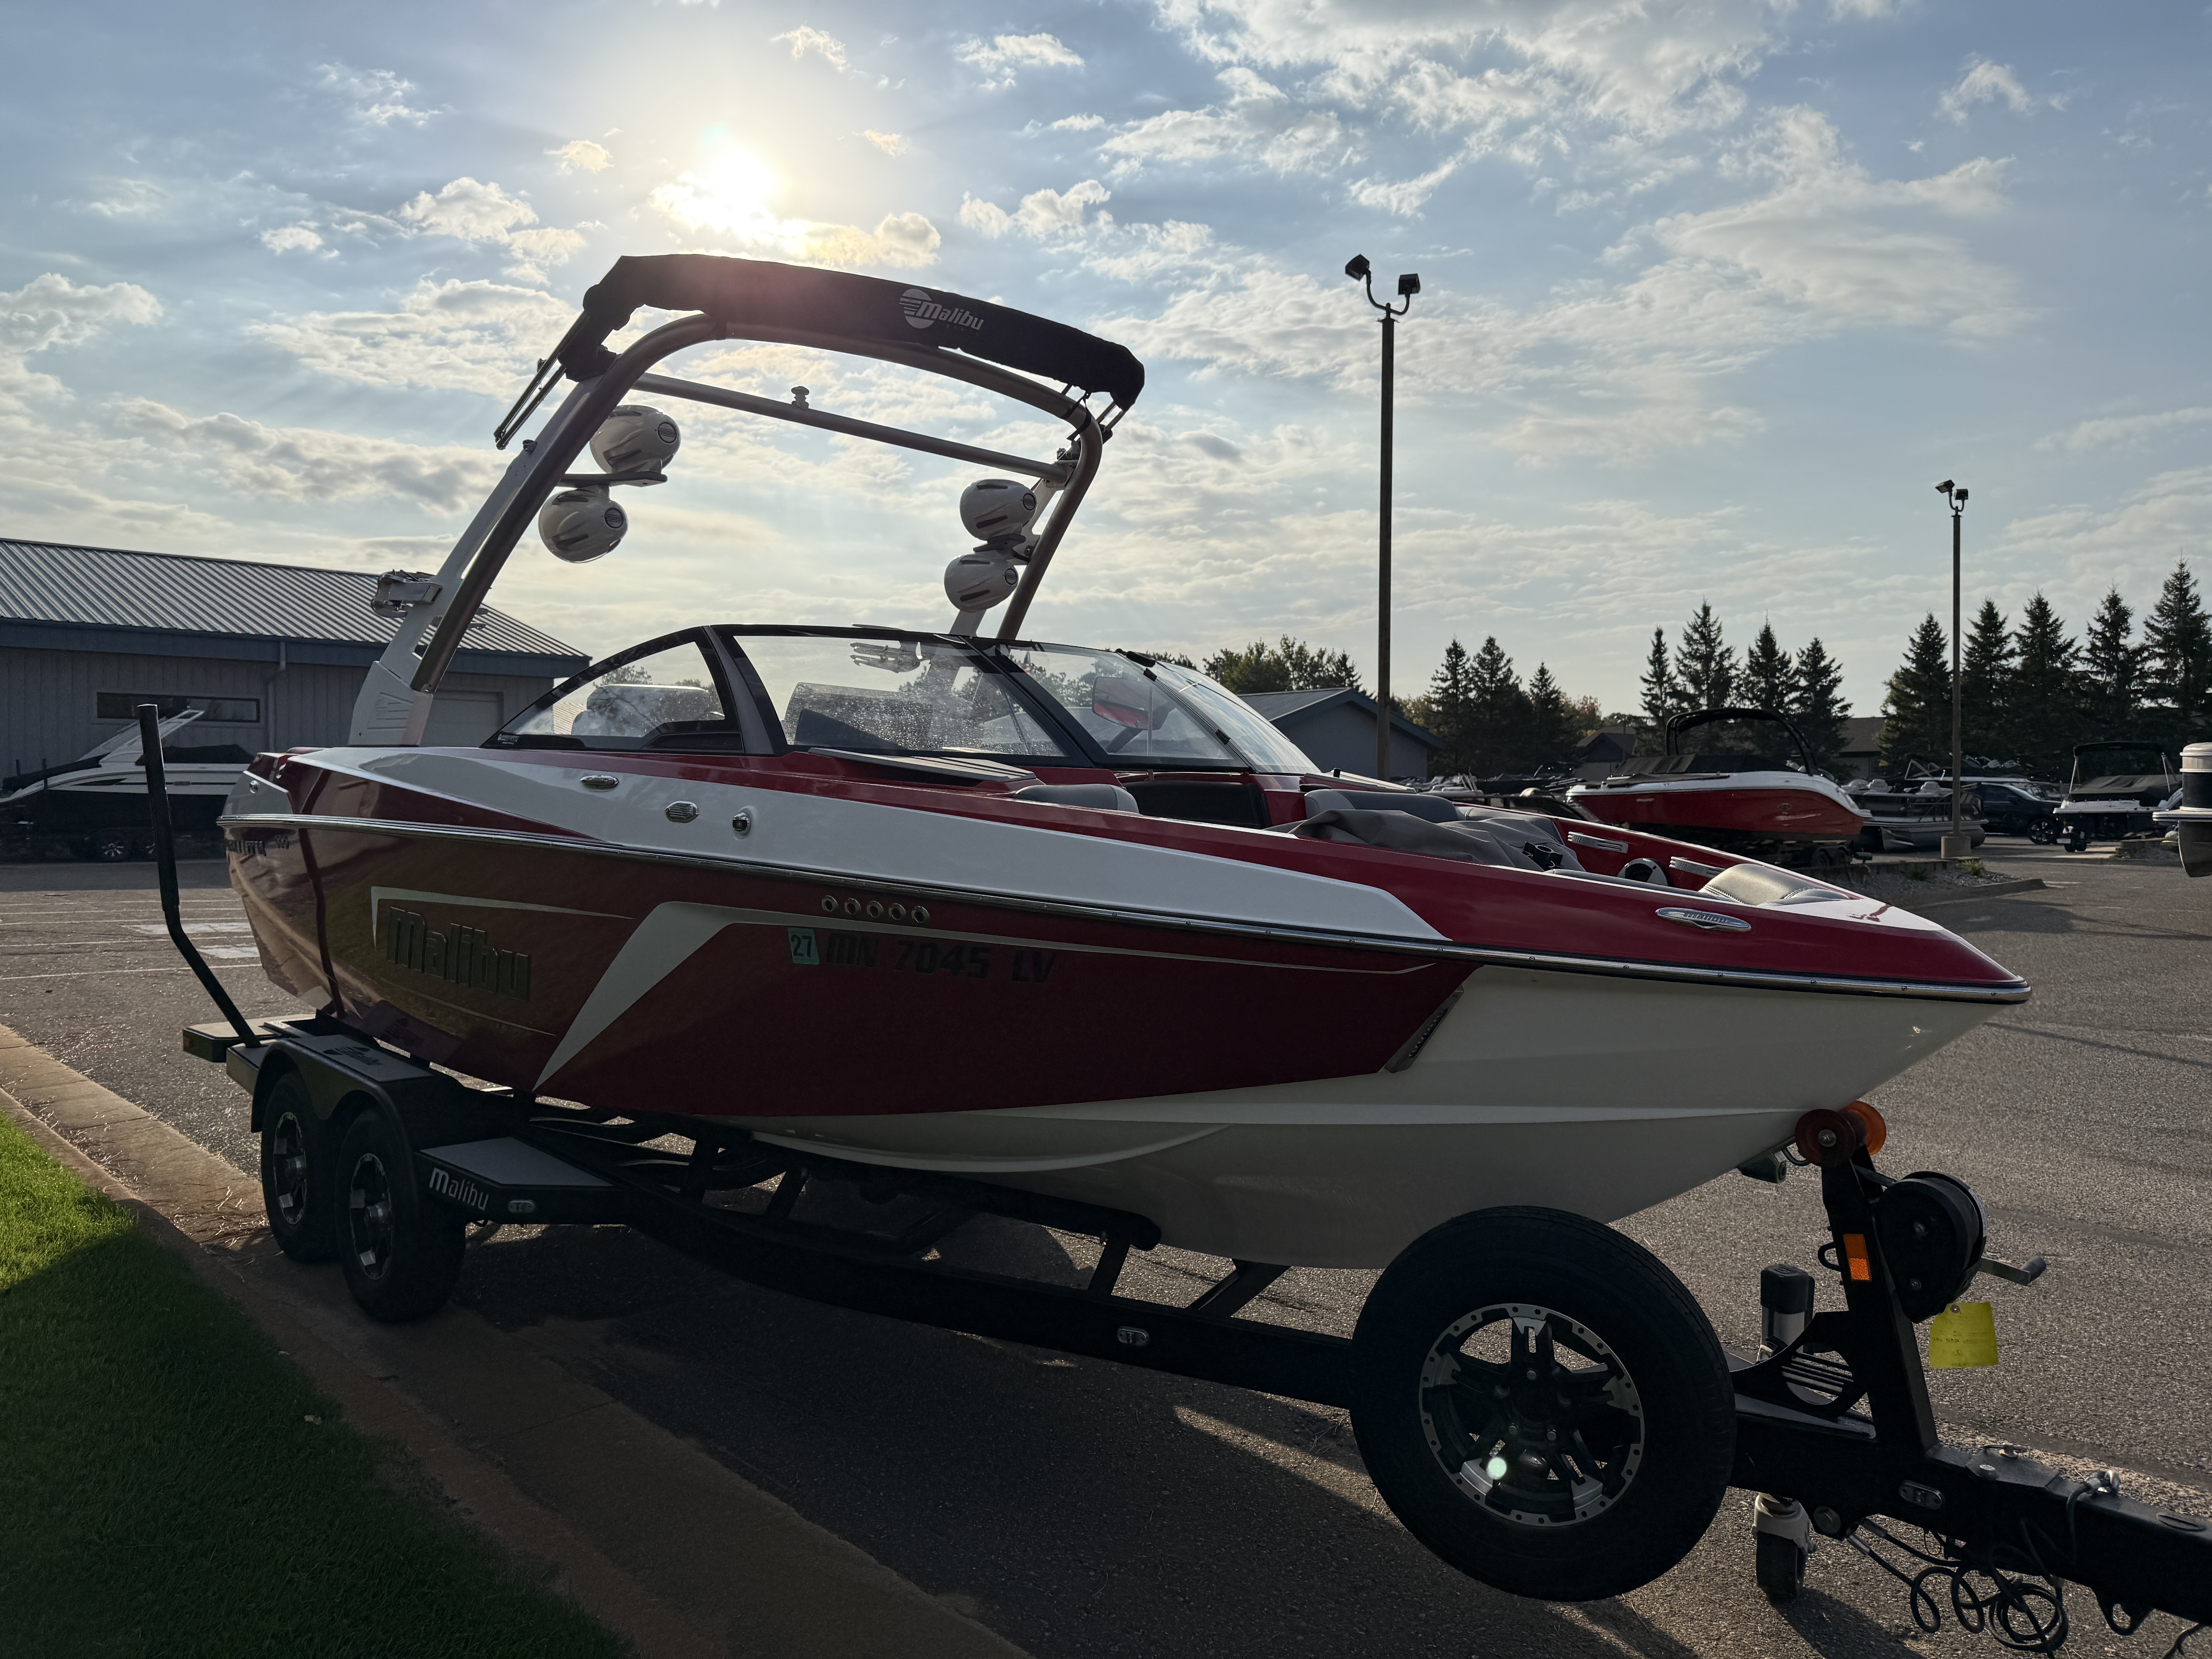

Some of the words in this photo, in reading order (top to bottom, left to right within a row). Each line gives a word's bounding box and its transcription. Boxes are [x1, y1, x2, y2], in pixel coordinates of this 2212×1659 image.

[915, 301, 984, 330] Malibu
[388, 906, 531, 1002] Malibu
[790, 934, 812, 958] 27
[826, 932, 879, 968] MN
[894, 940, 992, 979] 7045
[1012, 950, 1056, 983] LV
[429, 1167, 489, 1212] Malibu
